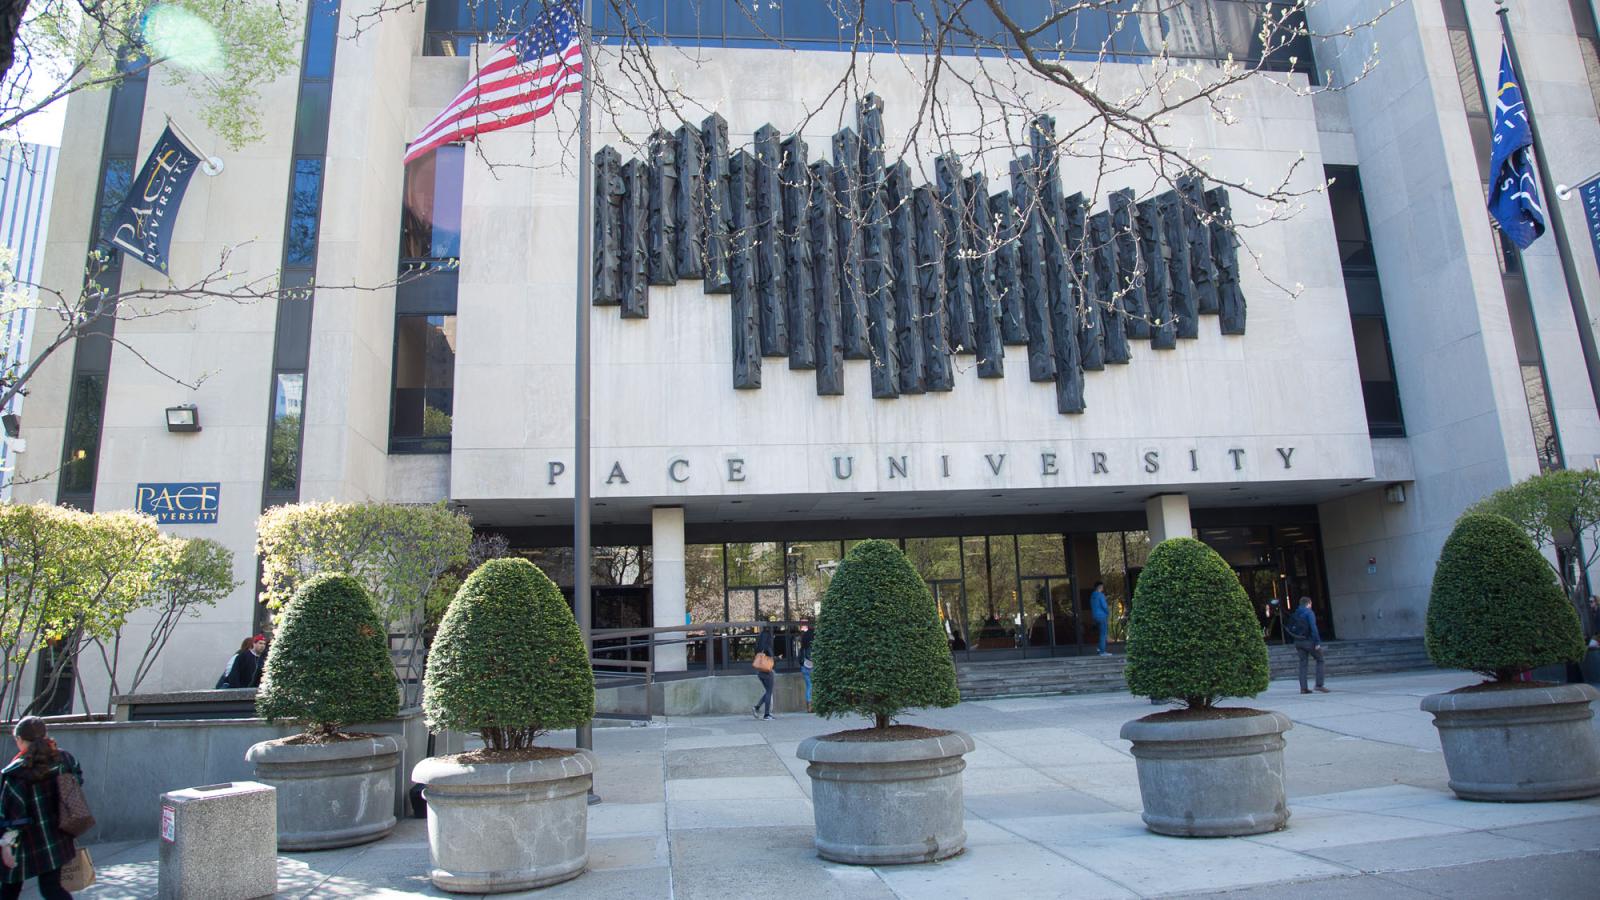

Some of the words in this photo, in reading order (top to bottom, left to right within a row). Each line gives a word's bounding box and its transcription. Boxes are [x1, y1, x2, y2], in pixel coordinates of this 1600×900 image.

[112, 143, 182, 257] PACE
[147, 156, 188, 263] UNIVERSITY
[138, 486, 217, 511] PACE
[548, 459, 746, 485] PACE
[833, 448, 1295, 480] UNIVERSITY
